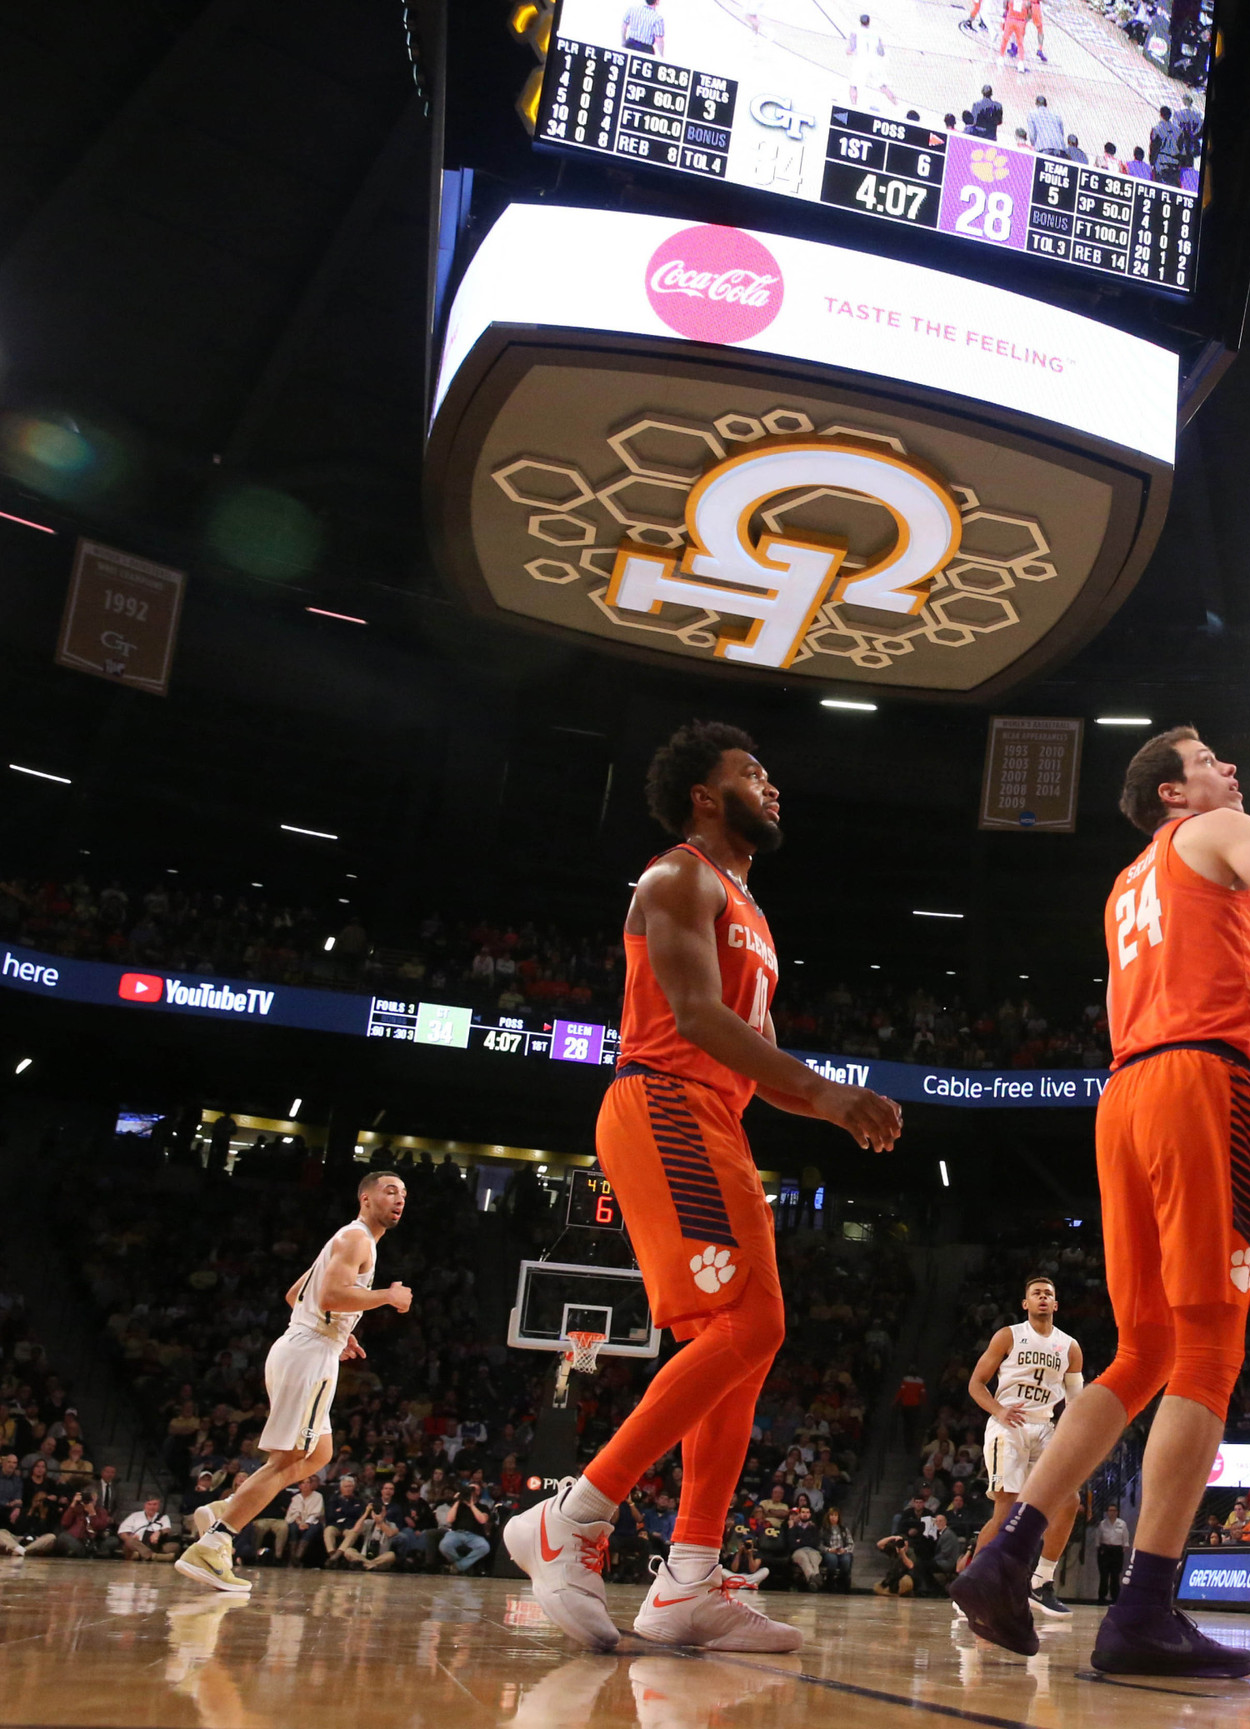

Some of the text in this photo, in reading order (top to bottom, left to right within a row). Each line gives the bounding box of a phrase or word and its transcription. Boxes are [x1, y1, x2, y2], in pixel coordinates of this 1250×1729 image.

[557, 39, 625, 66] PLR FL PTS
[564, 55, 618, 81] 1 2 3
[632, 59, 688, 88] FG 63.6
[559, 72, 616, 98] 4 0 6
[696, 86, 729, 103] FOULS
[700, 75, 727, 92] TEAM
[556, 88, 613, 114] 5 0 9
[626, 84, 685, 112] 3P 60.0
[703, 100, 716, 120] 3
[551, 103, 611, 130] 10 0 4
[622, 110, 681, 137] FT 100.0
[547, 120, 608, 147] 34 0 8
[687, 126, 726, 147] BONUS
[872, 119, 905, 140] POSS
[618, 136, 677, 163] REB 8
[839, 137, 931, 176] 1ST 6
[711, 158, 721, 173] 4
[1044, 161, 1069, 178] TEAM
[1039, 171, 1070, 188] FOULS
[1081, 173, 1132, 197] FG 38.5
[855, 174, 927, 220] 4:07
[1047, 187, 1059, 205] 5
[1137, 184, 1194, 208] PLR FL PTS
[955, 185, 1014, 241] 28
[1079, 196, 1129, 221] 3P 50.0
[1143, 199, 1190, 223] 2 0 0
[1032, 211, 1068, 231] BONUS
[1076, 220, 1128, 245] FT 100.0
[1141, 215, 1189, 239] 4 1 8
[1055, 240, 1066, 255] 3
[1138, 230, 1191, 256] 10 0 16
[1075, 245, 1125, 269] REB 14
[1135, 245, 1186, 271] 20 1 2
[650, 260, 780, 308] Coca-Cola
[1133, 261, 1185, 286] 24 1 0
[824, 296, 902, 328] TASTE
[911, 317, 957, 342] THE
[104, 589, 149, 622] 1992
[1040, 746, 1064, 757] 2010
[1003, 758, 1061, 770] 2003 2011
[1001, 771, 1061, 783] 2007 2012
[999, 797, 1025, 808] 2009
[1000, 784, 1060, 797] 2008 2014
[1116, 866, 1163, 971] 24
[2, 952, 59, 986] here
[376, 1000, 414, 1014] FOULS 3
[407, 1030, 413, 1041] 3
[428, 1020, 453, 1044] 34
[500, 1017, 523, 1030] POSS
[567, 1024, 592, 1036] CLEM
[483, 1031, 522, 1052] 4:07
[531, 1040, 547, 1051] 1ST
[563, 1037, 589, 1059] 28
[923, 1075, 1110, 1098] Cable-free live TV
[596, 1196, 613, 1223] 6
[1018, 1351, 1062, 1371] GEORGIA
[1034, 1369, 1044, 1385] 4
[1017, 1384, 1051, 1404] TECH
